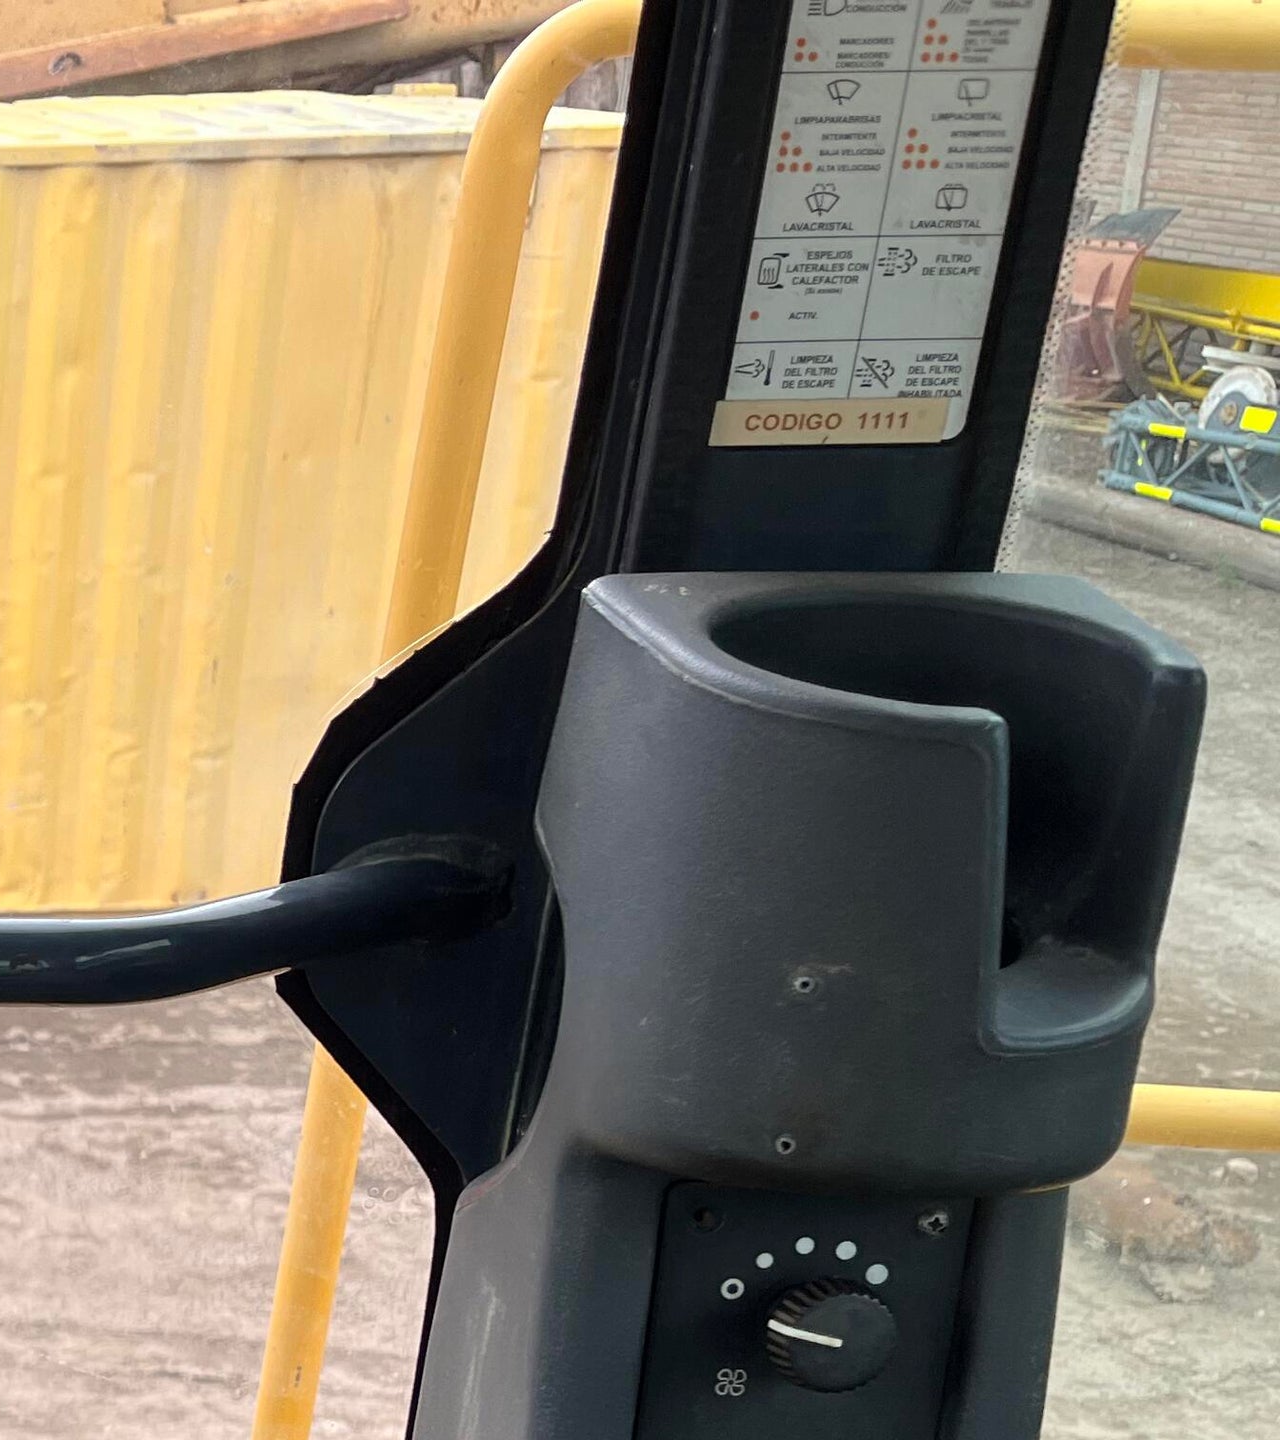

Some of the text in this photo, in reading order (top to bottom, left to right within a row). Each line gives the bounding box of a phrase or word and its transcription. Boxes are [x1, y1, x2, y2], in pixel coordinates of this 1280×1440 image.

[783, 221, 854, 232] LAVACRISTAL
[910, 219, 981, 229] LAVACRISTAL
[807, 250, 853, 260] ESPEJOS
[935, 253, 972, 264] FILTRO
[786, 262, 869, 273] LATERALES CON
[922, 266, 982, 276] DE ESCAPE
[792, 275, 859, 286] CALEFACTOR
[790, 355, 834, 365] LIMPIEZA
[915, 353, 959, 363] LIMPIEZA
[784, 367, 838, 377] DEL FILTRO
[908, 364, 962, 375] DEL FILTRO
[781, 379, 836, 389] DE ESCAPE
[905, 376, 959, 387] DE ESCAPE
[744, 411, 910, 432] CODIGO 1111
